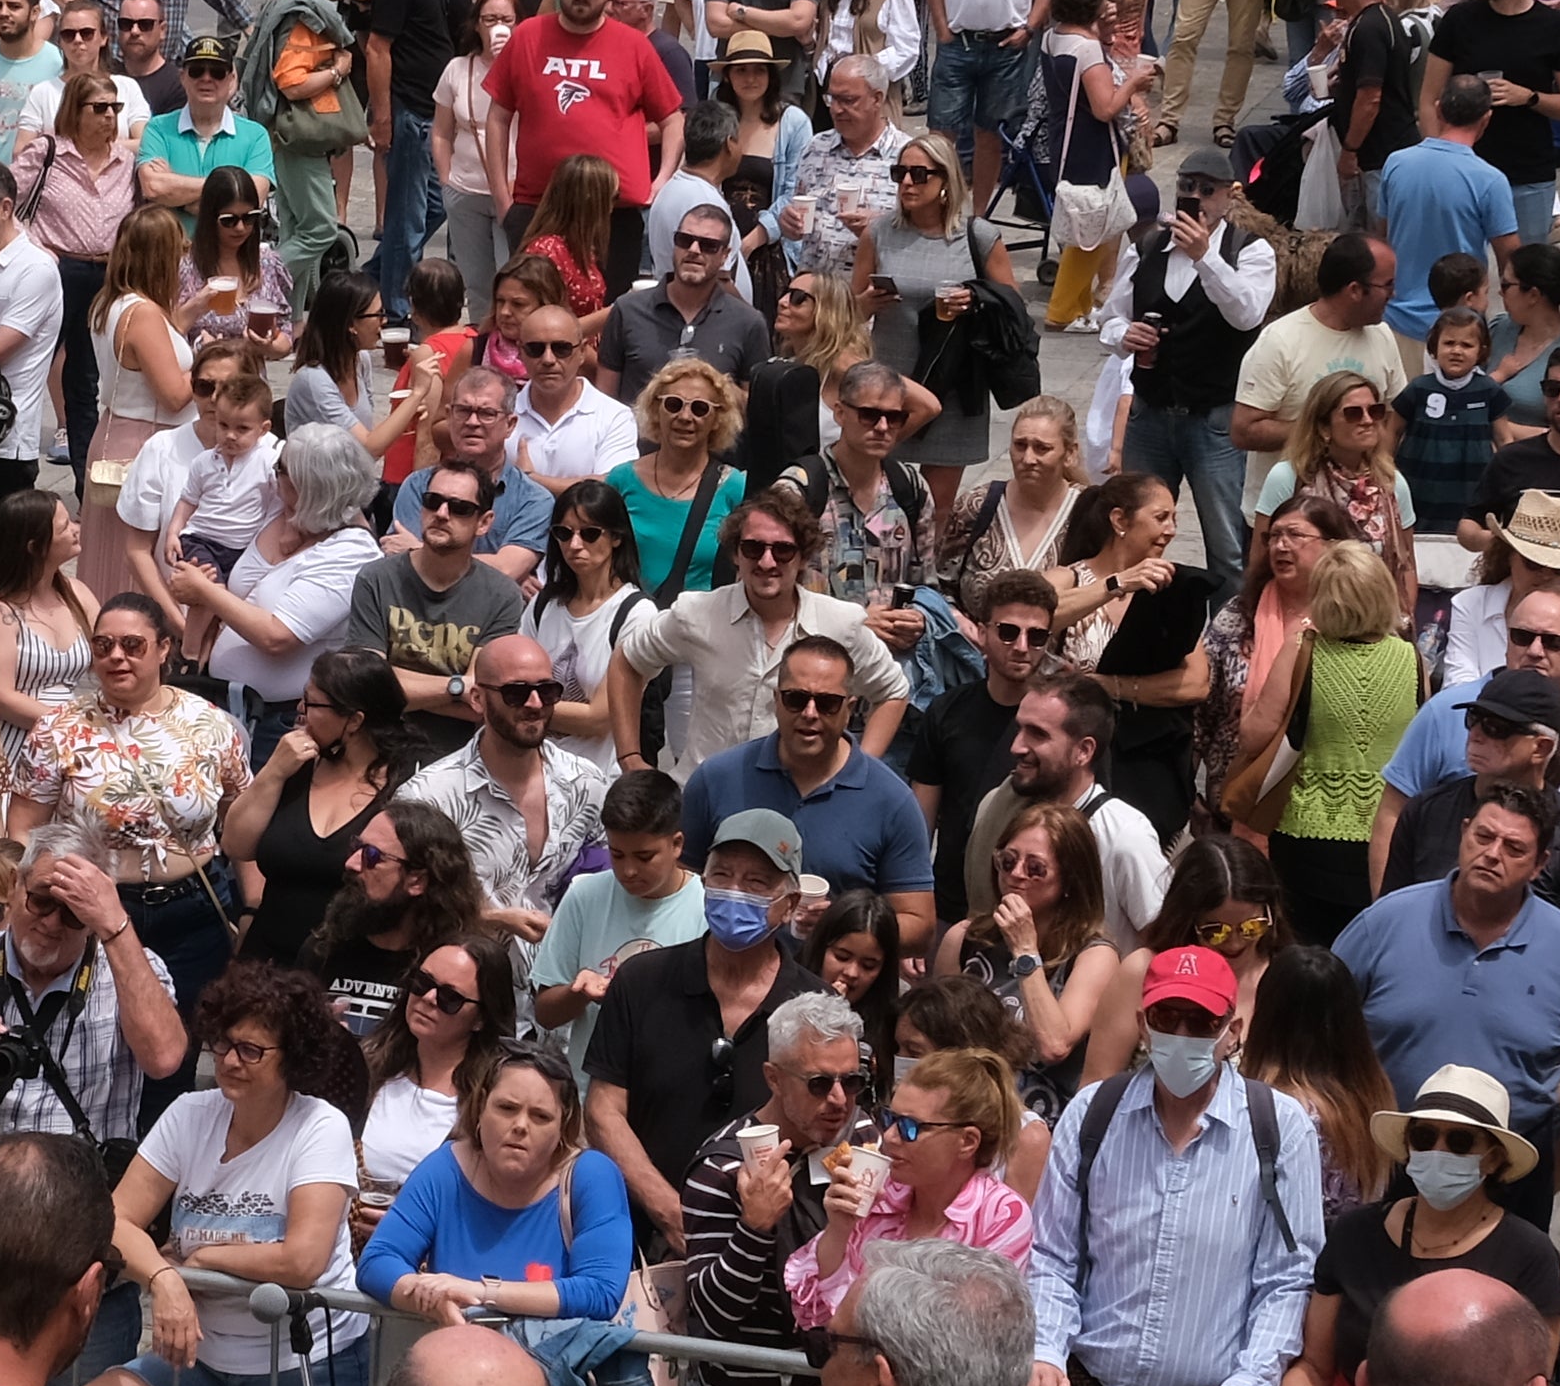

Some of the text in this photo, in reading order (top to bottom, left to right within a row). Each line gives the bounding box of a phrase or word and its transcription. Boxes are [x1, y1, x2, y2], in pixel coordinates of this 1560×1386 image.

[542, 56, 608, 80] ATL
[1425, 393, 1447, 419] 9
[1174, 952, 1200, 976] A
[329, 977, 399, 1000] ADVENT
